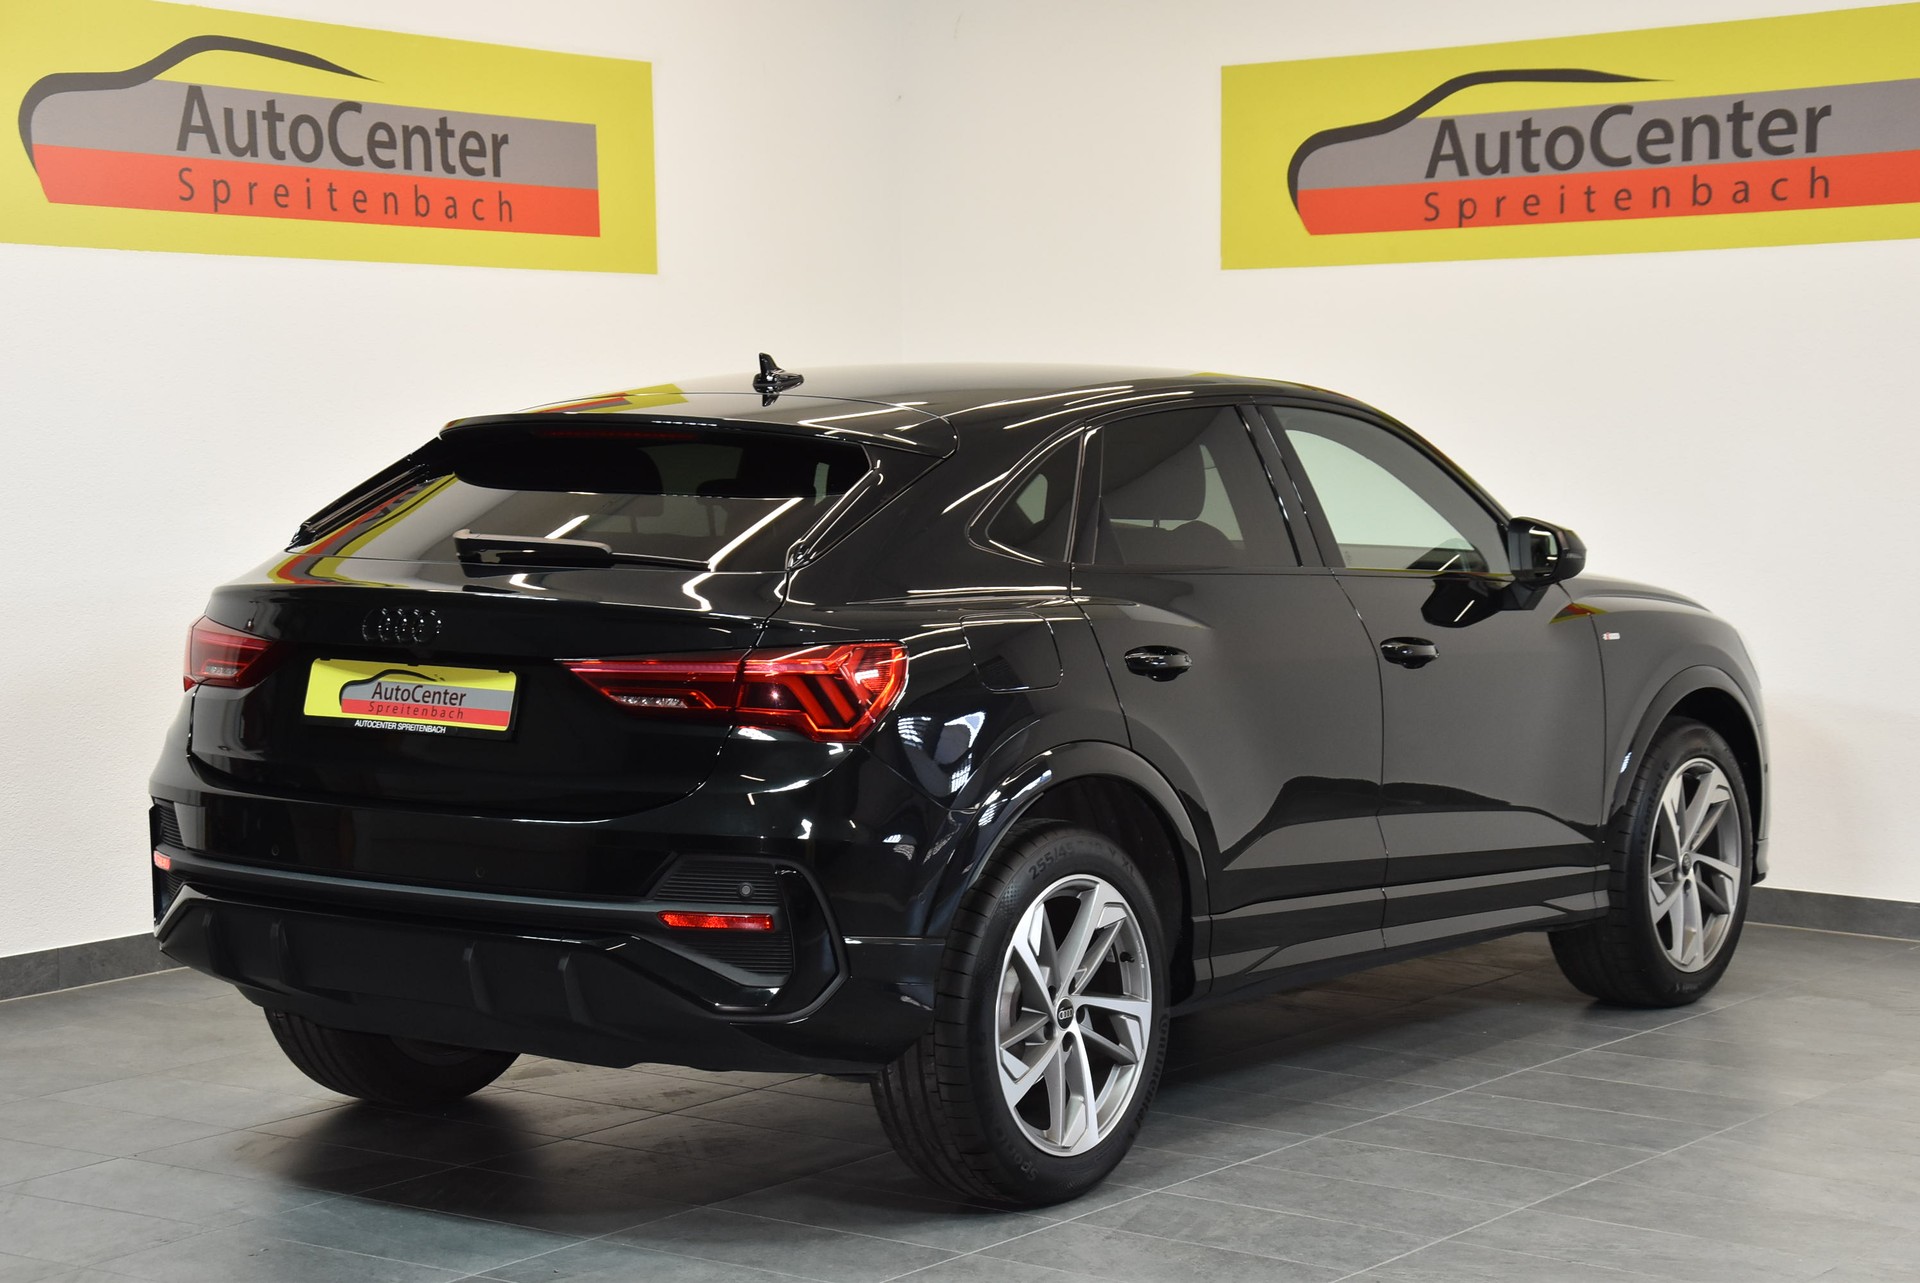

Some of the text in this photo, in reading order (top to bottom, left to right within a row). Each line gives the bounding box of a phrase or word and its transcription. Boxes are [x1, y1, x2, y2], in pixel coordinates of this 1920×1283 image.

[176, 85, 509, 179] AutoCenter
[1424, 99, 1832, 179] AutoCenter
[178, 167, 514, 223] Spreitenbach
[1424, 166, 1831, 228] Spreitenbach
[369, 702, 463, 719] Spreitenbach
[372, 682, 466, 706] AutoCenter
[355, 720, 446, 733] AUTOCENTER SPREITENBACH
